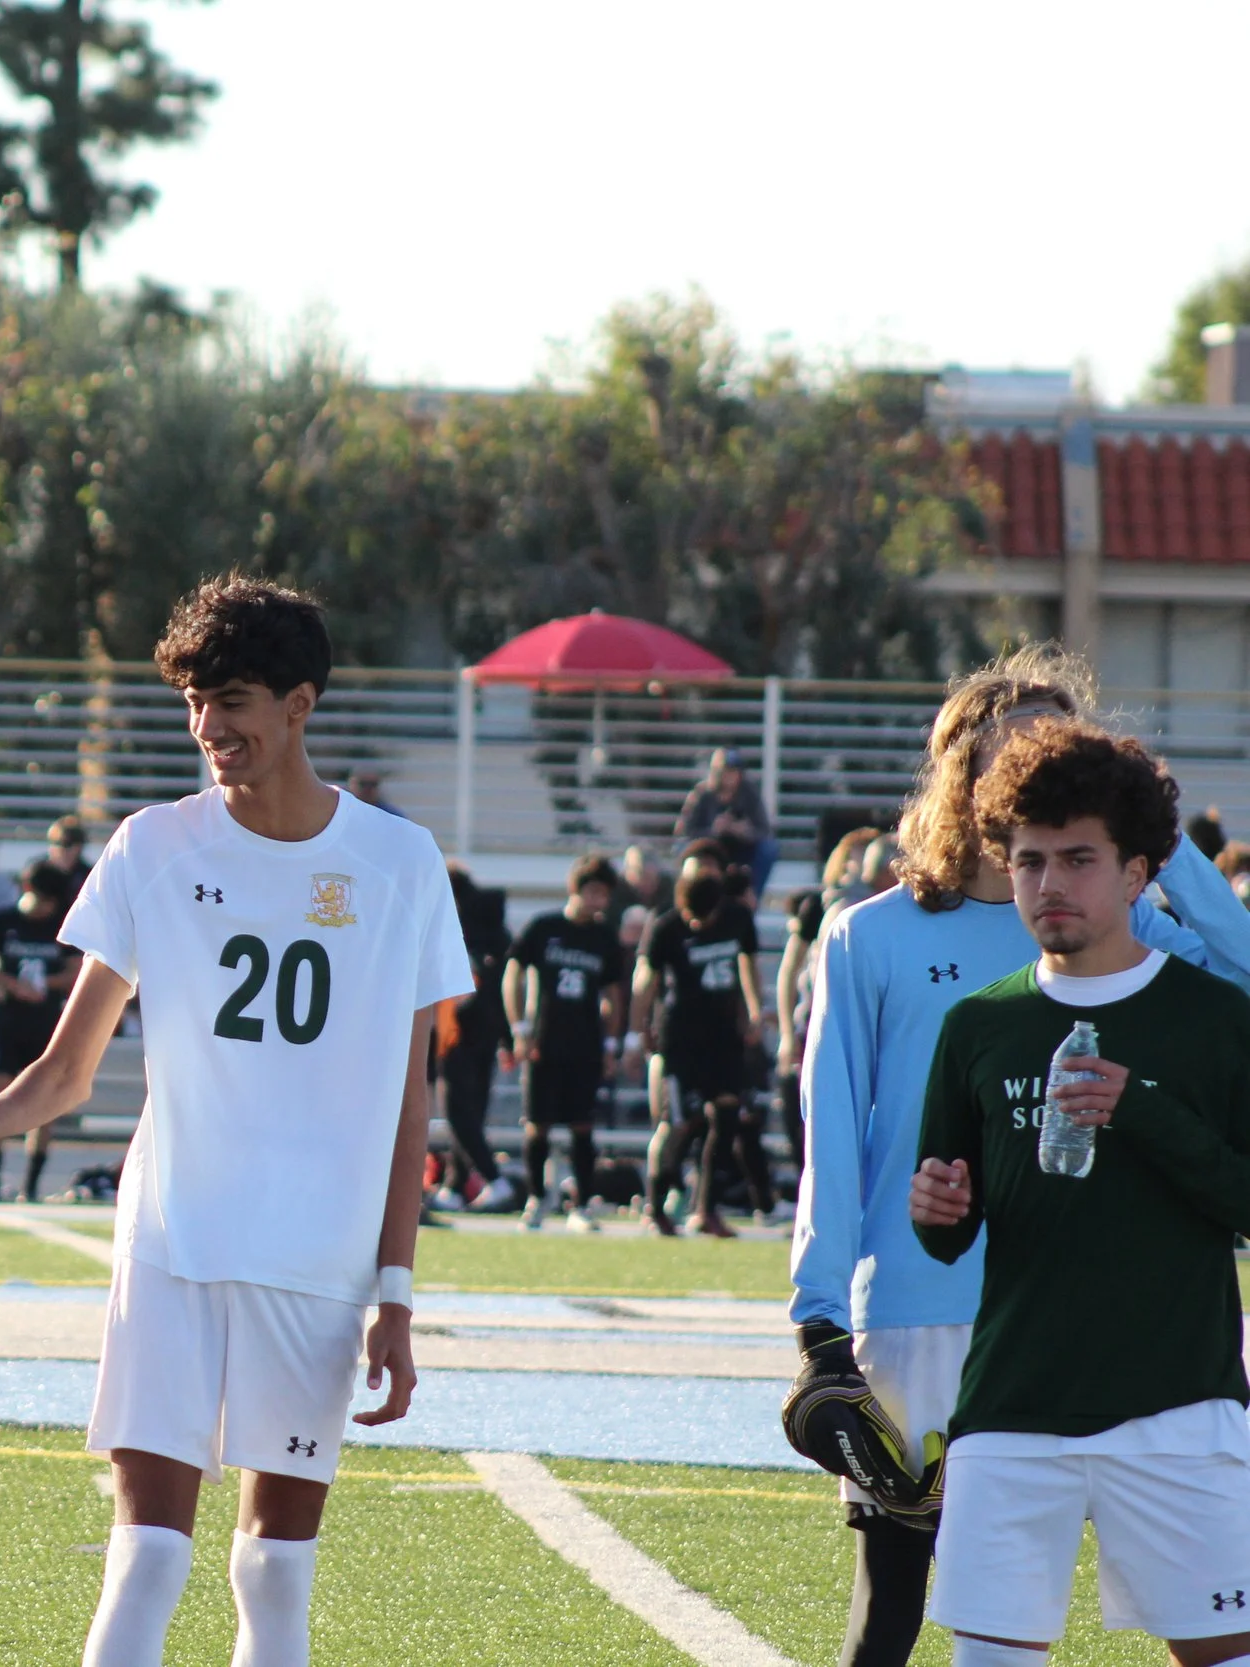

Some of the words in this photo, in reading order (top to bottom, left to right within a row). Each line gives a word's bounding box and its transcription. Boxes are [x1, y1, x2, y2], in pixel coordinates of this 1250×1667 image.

[213, 934, 331, 1045] 20
[701, 959, 737, 990] 45
[835, 1430, 874, 1487] reusch
